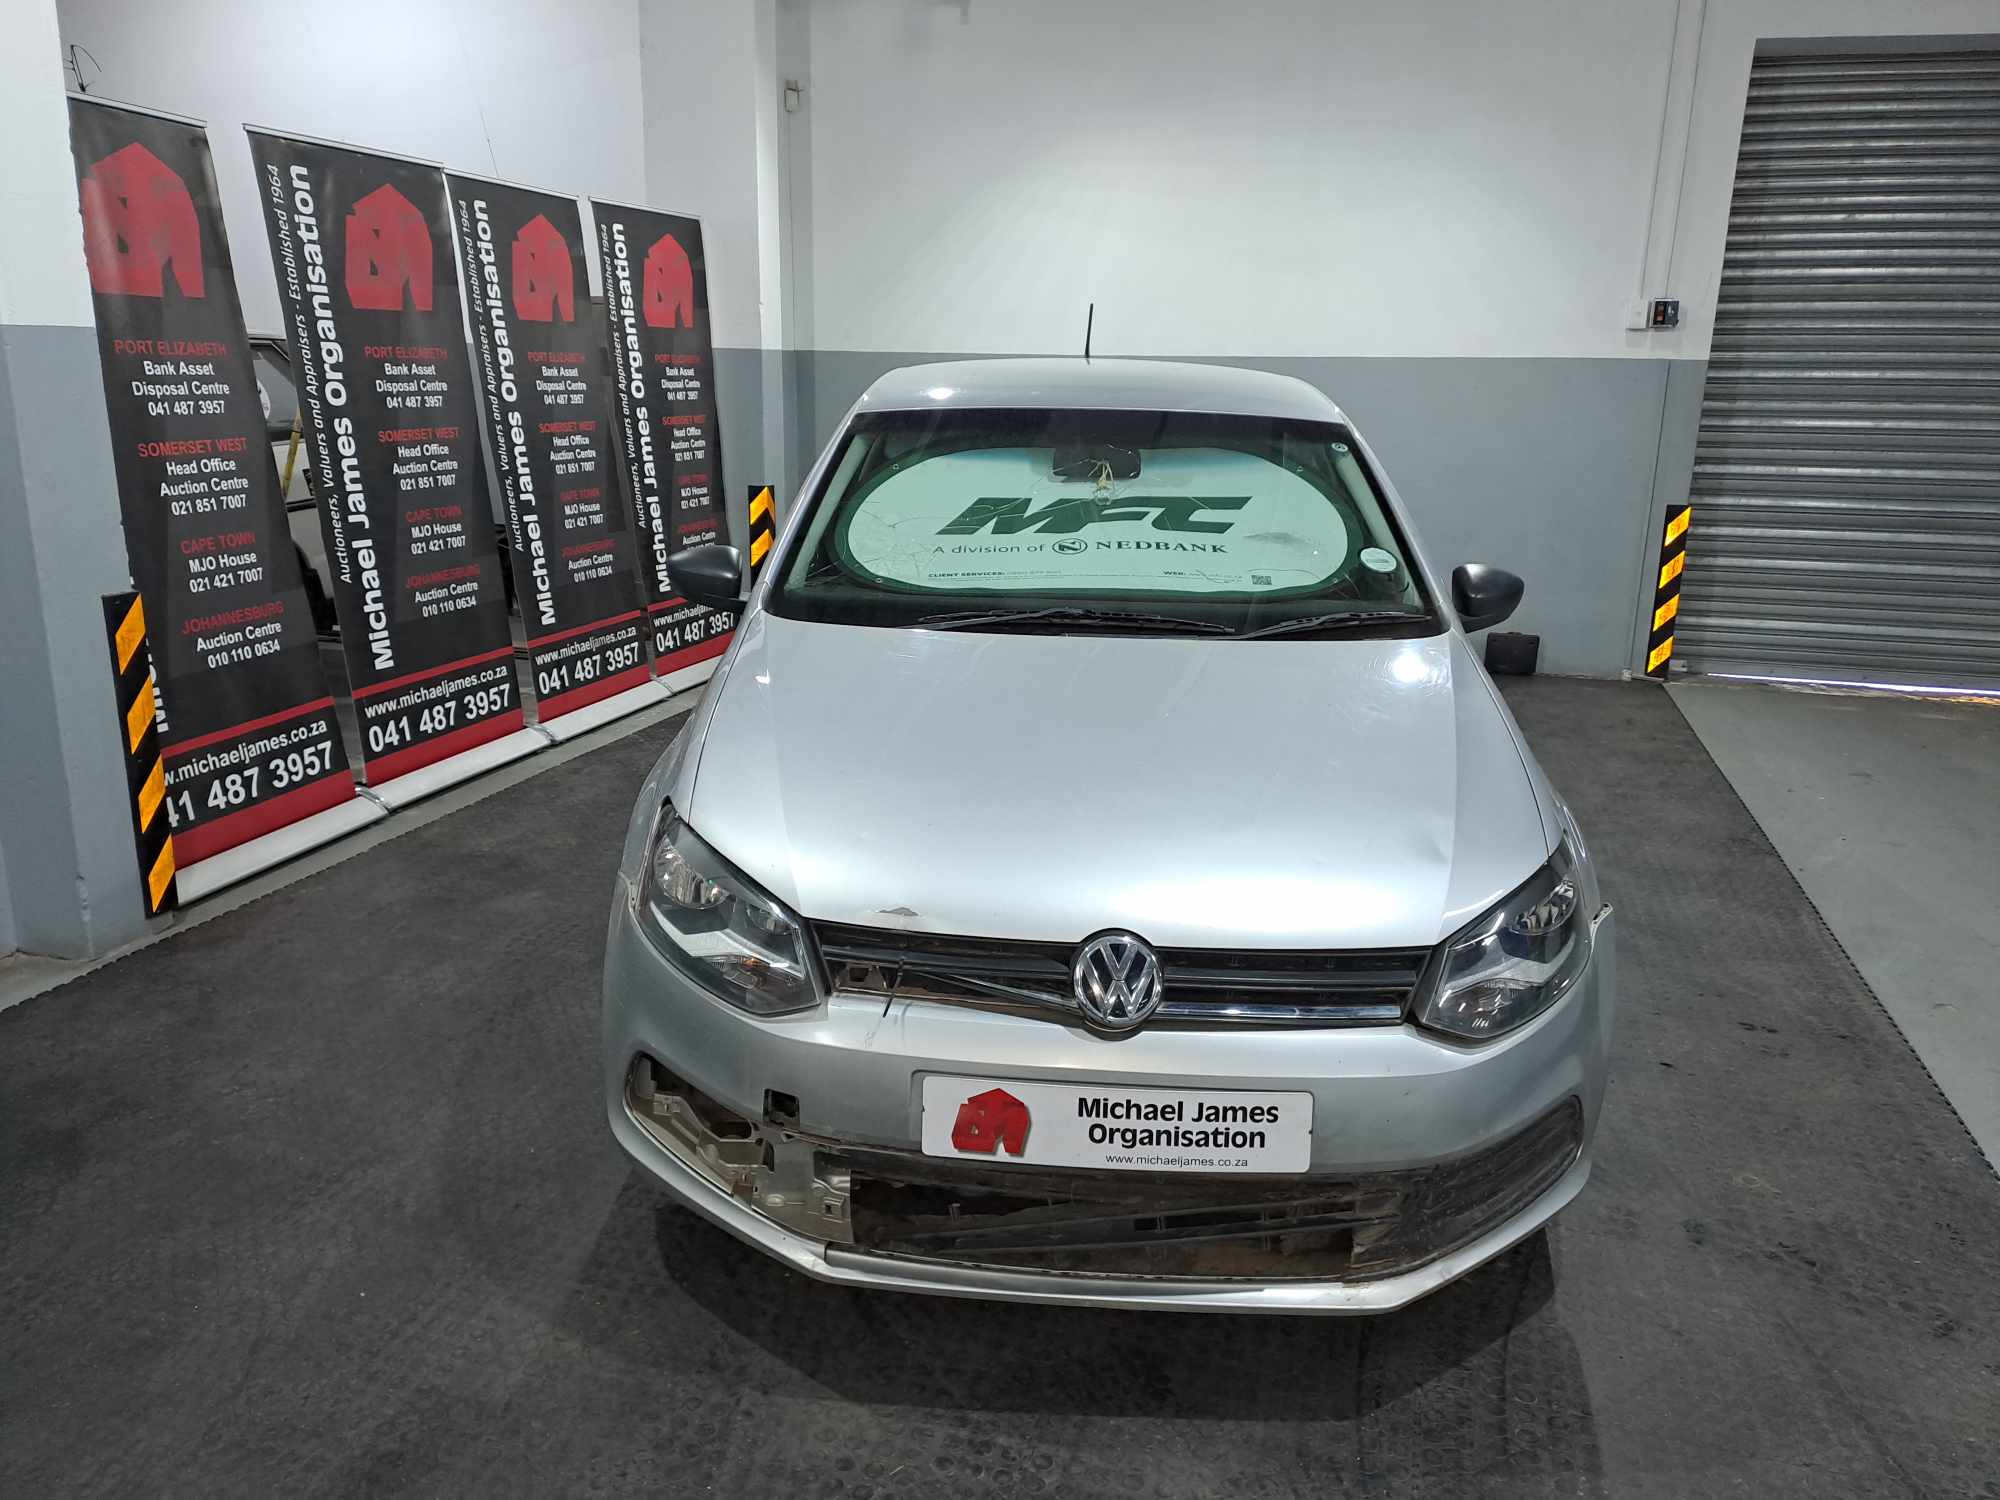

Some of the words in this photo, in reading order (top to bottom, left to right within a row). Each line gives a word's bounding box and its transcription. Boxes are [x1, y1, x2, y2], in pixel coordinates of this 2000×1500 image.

[267, 164, 283, 204] 1964
[273, 209, 301, 301] Established
[290, 165, 347, 406] Organisation
[474, 200, 517, 402] Organisation
[612, 223, 644, 399] Organisation
[114, 340, 152, 354] PORT
[157, 340, 226, 356] ELIZABETH
[296, 314, 319, 396] Appraisers
[364, 346, 393, 358] PORT
[144, 360, 176, 376] Bank
[180, 361, 214, 376] Asset
[384, 363, 409, 375] Bank
[412, 364, 436, 375] Asset
[542, 366, 558, 376] Bank
[132, 381, 189, 398] Disposal
[192, 380, 229, 395] Centre
[376, 380, 417, 394] Disposal
[420, 380, 447, 391] Centre
[536, 380, 565, 392] Disposal
[148, 402, 170, 416] 041
[174, 401, 194, 415] 487
[199, 400, 224, 414] 3957
[308, 398, 324, 428] and
[386, 397, 402, 408] 041
[405, 396, 421, 408] 487
[425, 396, 442, 407] 3957
[489, 396, 500, 420] and
[619, 393, 630, 415] and
[378, 428, 433, 442] SOMERSET
[496, 424, 509, 470] Valuers
[624, 418, 636, 458] Valuers
[138, 440, 212, 457] SOMERSET
[216, 438, 246, 451] WEST
[397, 446, 421, 457] Head
[423, 444, 449, 455] Office
[508, 412, 535, 505] James
[550, 451, 574, 460] Auction
[636, 407, 657, 488] James
[166, 461, 197, 476] Head
[201, 458, 236, 472] Office
[315, 432, 334, 488] Valuers
[393, 463, 428, 474] Auction
[430, 460, 458, 471] Centre
[334, 418, 369, 529] James
[400, 479, 416, 490] 021
[418, 477, 434, 488] 851
[437, 474, 455, 487] 7007
[160, 480, 208, 496] Auction
[211, 477, 248, 491] Centre
[172, 501, 192, 516] 021
[197, 498, 217, 513] 851
[222, 494, 246, 510] 7007
[505, 476, 524, 551] Auctioneers,
[580, 503, 600, 513] House
[935, 496, 1253, 535] MFC
[411, 525, 431, 538] MJO
[433, 523, 461, 534] House
[577, 516, 587, 526] 421
[180, 537, 216, 554] CAPE
[219, 532, 256, 548] TOWN
[328, 494, 352, 583] Auctioneers,
[411, 543, 426, 554] 021
[429, 539, 444, 551] 421
[446, 536, 466, 548] 7007
[646, 496, 671, 592] Michael
[933, 546, 944, 554] A
[951, 545, 1020, 553] division
[1027, 544, 1045, 552] of
[1096, 540, 1228, 553] NEDBANK
[189, 556, 216, 573] MJO
[219, 552, 256, 567] House
[523, 515, 555, 625] Michael
[569, 558, 592, 570] Auction
[586, 568, 596, 579] 110
[189, 578, 210, 593] 021
[214, 574, 234, 588] 421
[239, 568, 263, 583] 7007
[415, 589, 448, 603] Auction
[450, 582, 478, 594] Centre
[352, 539, 395, 670] Michael
[423, 605, 437, 617] 010
[440, 601, 454, 612] 110
[456, 596, 476, 609] 0634
[182, 602, 284, 635] JOHANNESBURG
[197, 632, 242, 652] Auction
[246, 622, 282, 639] Centre
[656, 627, 680, 652] 041
[684, 620, 705, 642] 487
[709, 611, 734, 635] 3957
[208, 653, 228, 668] 010
[231, 647, 251, 662] 110
[255, 639, 280, 656] 0634
[535, 626, 636, 666] www.michaeljames.co.za
[538, 666, 569, 694] 041
[574, 655, 600, 682] 487
[605, 642, 639, 671] 3957
[365, 666, 507, 718] www.michaeljames.co.za
[369, 716, 411, 752] 041
[419, 701, 456, 734] 487
[464, 684, 510, 720] 3957
[164, 720, 327, 786] w.michaeljames.co.za
[166, 790, 195, 828] 41
[208, 767, 259, 810] 487
[269, 741, 332, 789] 3957
[1078, 1097, 1184, 1122] Michael
[1191, 1102, 1279, 1123] James
[1089, 1123, 1265, 1149] Organisation
[1105, 1155, 1248, 1168] www.michaeljames.co.za
